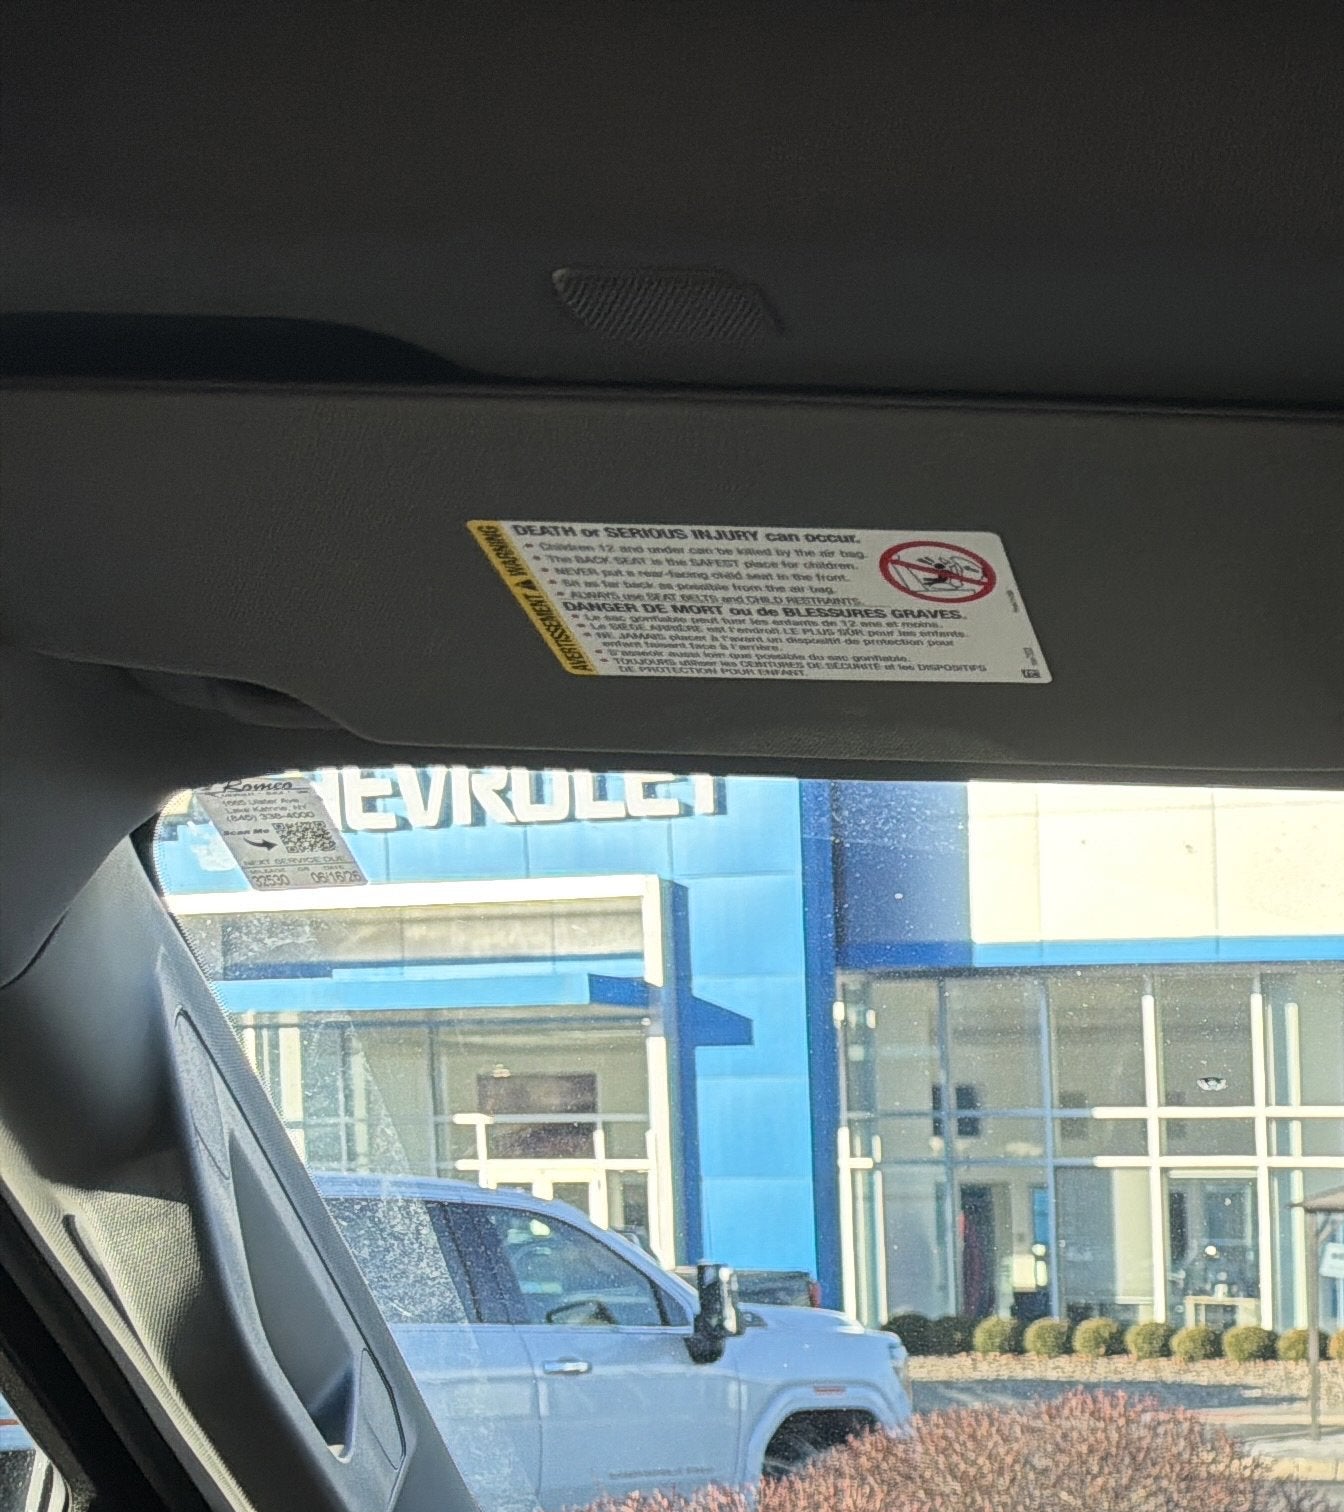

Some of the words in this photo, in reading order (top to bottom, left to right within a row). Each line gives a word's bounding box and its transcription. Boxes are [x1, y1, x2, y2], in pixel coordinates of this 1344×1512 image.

[476, 524, 526, 578] WARNING
[512, 525, 577, 537] DEATH
[581, 528, 600, 538] or
[604, 527, 688, 539] SERIOUS
[691, 529, 758, 541] INJURY
[765, 532, 800, 542] can
[805, 533, 861, 543] occur.
[563, 601, 638, 613] DANGER
[642, 603, 667, 614] DE
[672, 604, 722, 615] MORT
[730, 607, 753, 616] ou
[758, 607, 779, 617] de
[783, 607, 886, 619] BLESSURES
[891, 609, 966, 620] GRAVES.
[524, 587, 591, 672] AVERTISSEMENT
